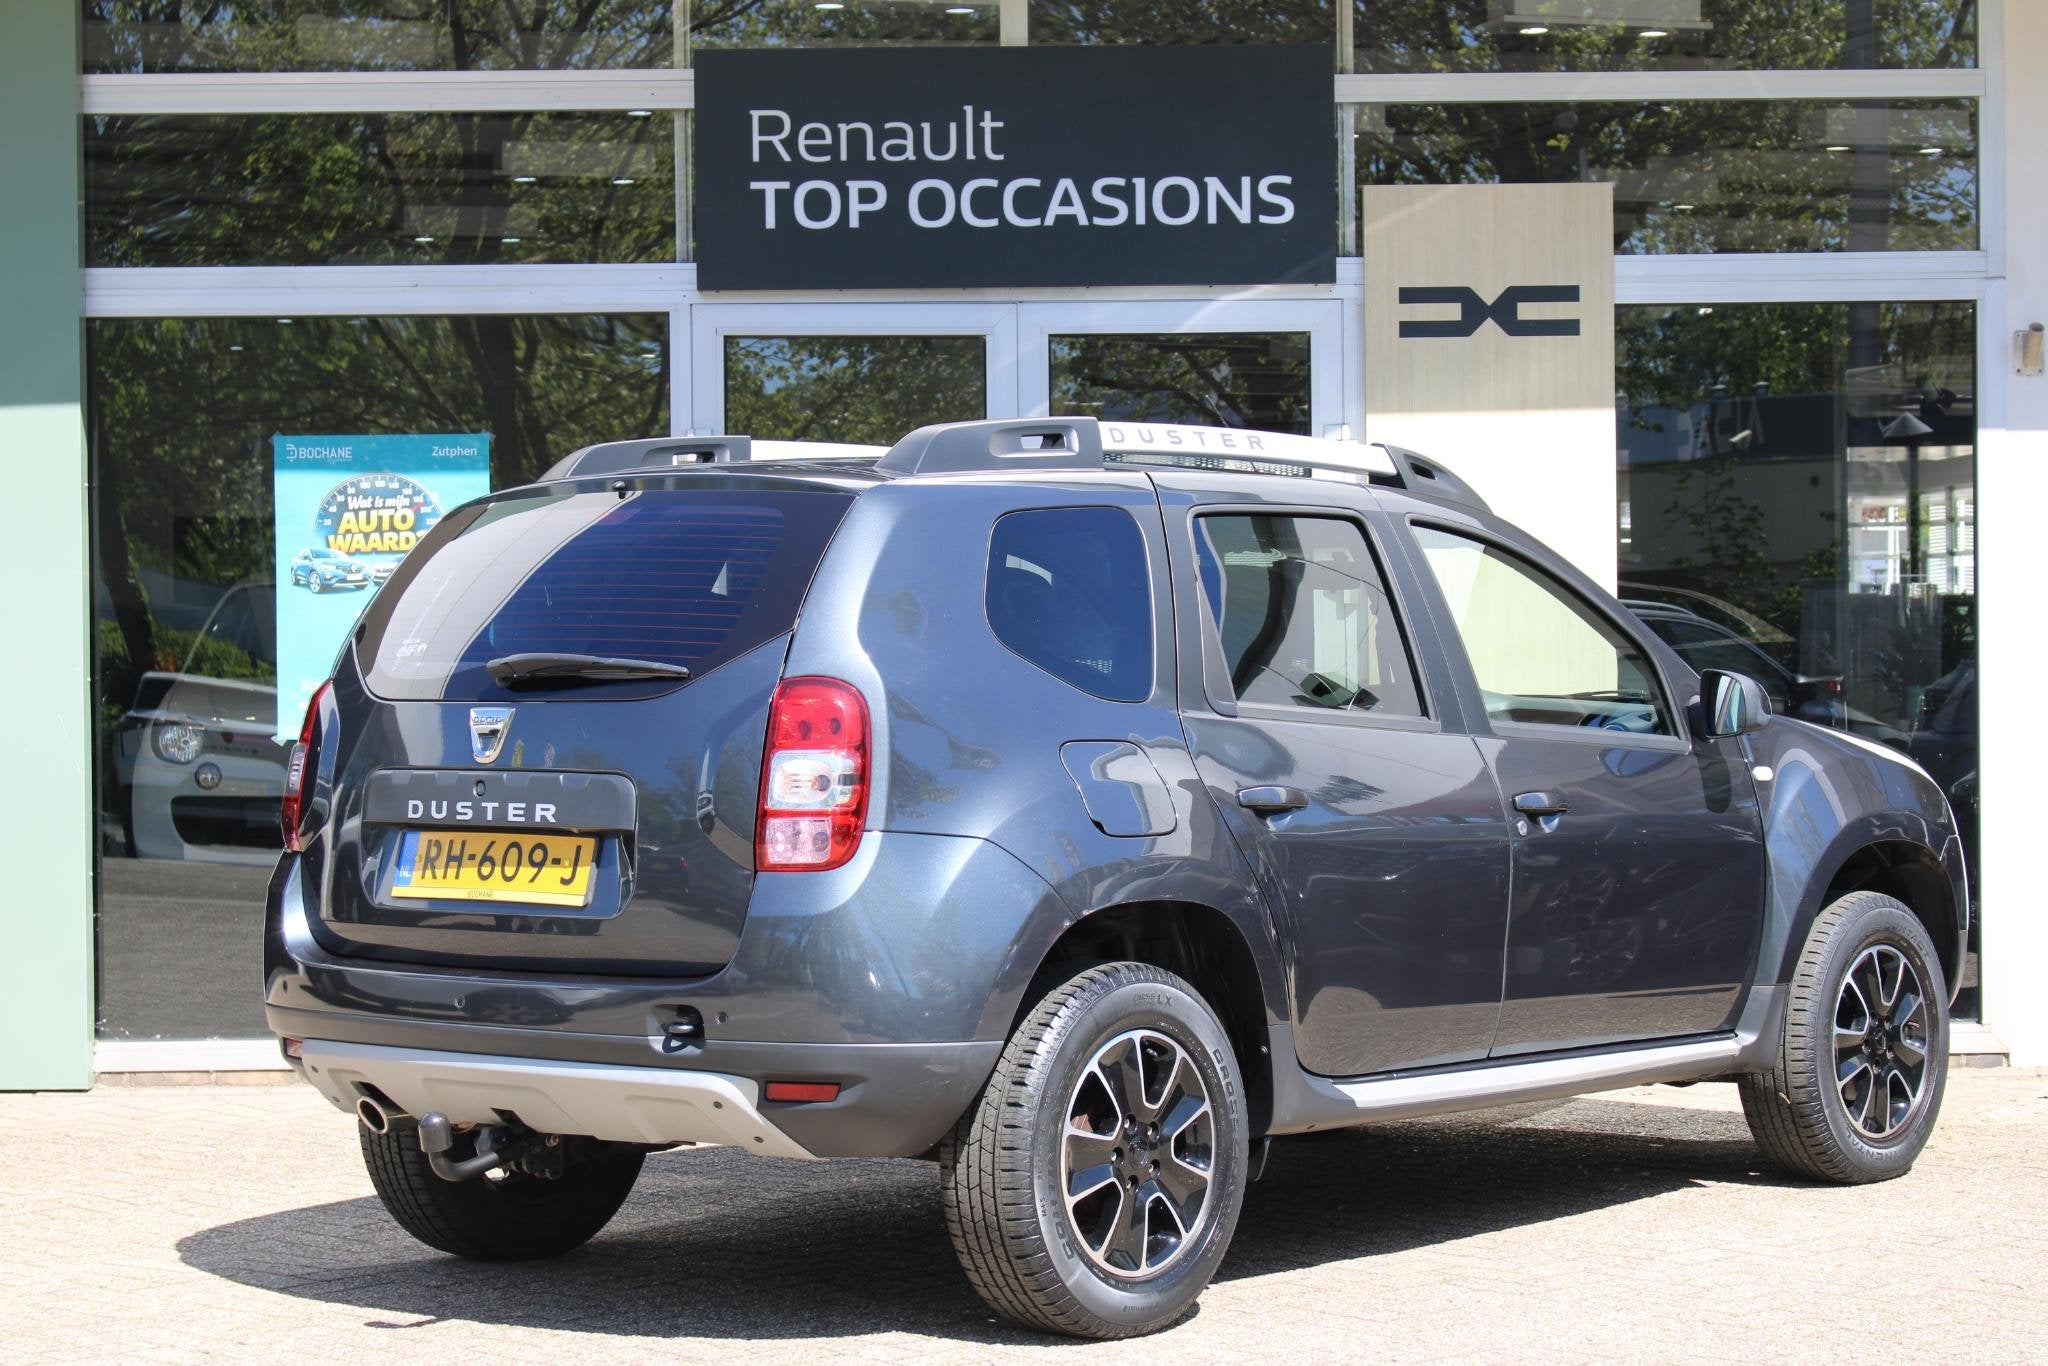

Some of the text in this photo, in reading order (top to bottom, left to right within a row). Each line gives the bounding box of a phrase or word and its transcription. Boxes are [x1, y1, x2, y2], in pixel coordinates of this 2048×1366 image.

[749, 105, 1004, 163] Renault
[750, 175, 1295, 229] TOP OCCASIONS
[1108, 426, 1265, 450] DUSTER
[299, 447, 352, 459] BOCHANE
[432, 446, 477, 459] Zutphen
[347, 494, 410, 511] Wat is mijn
[338, 507, 415, 535] AUTO
[408, 799, 557, 823] DUSTER
[399, 865, 411, 878] NL
[421, 839, 582, 887] RH-609-J
